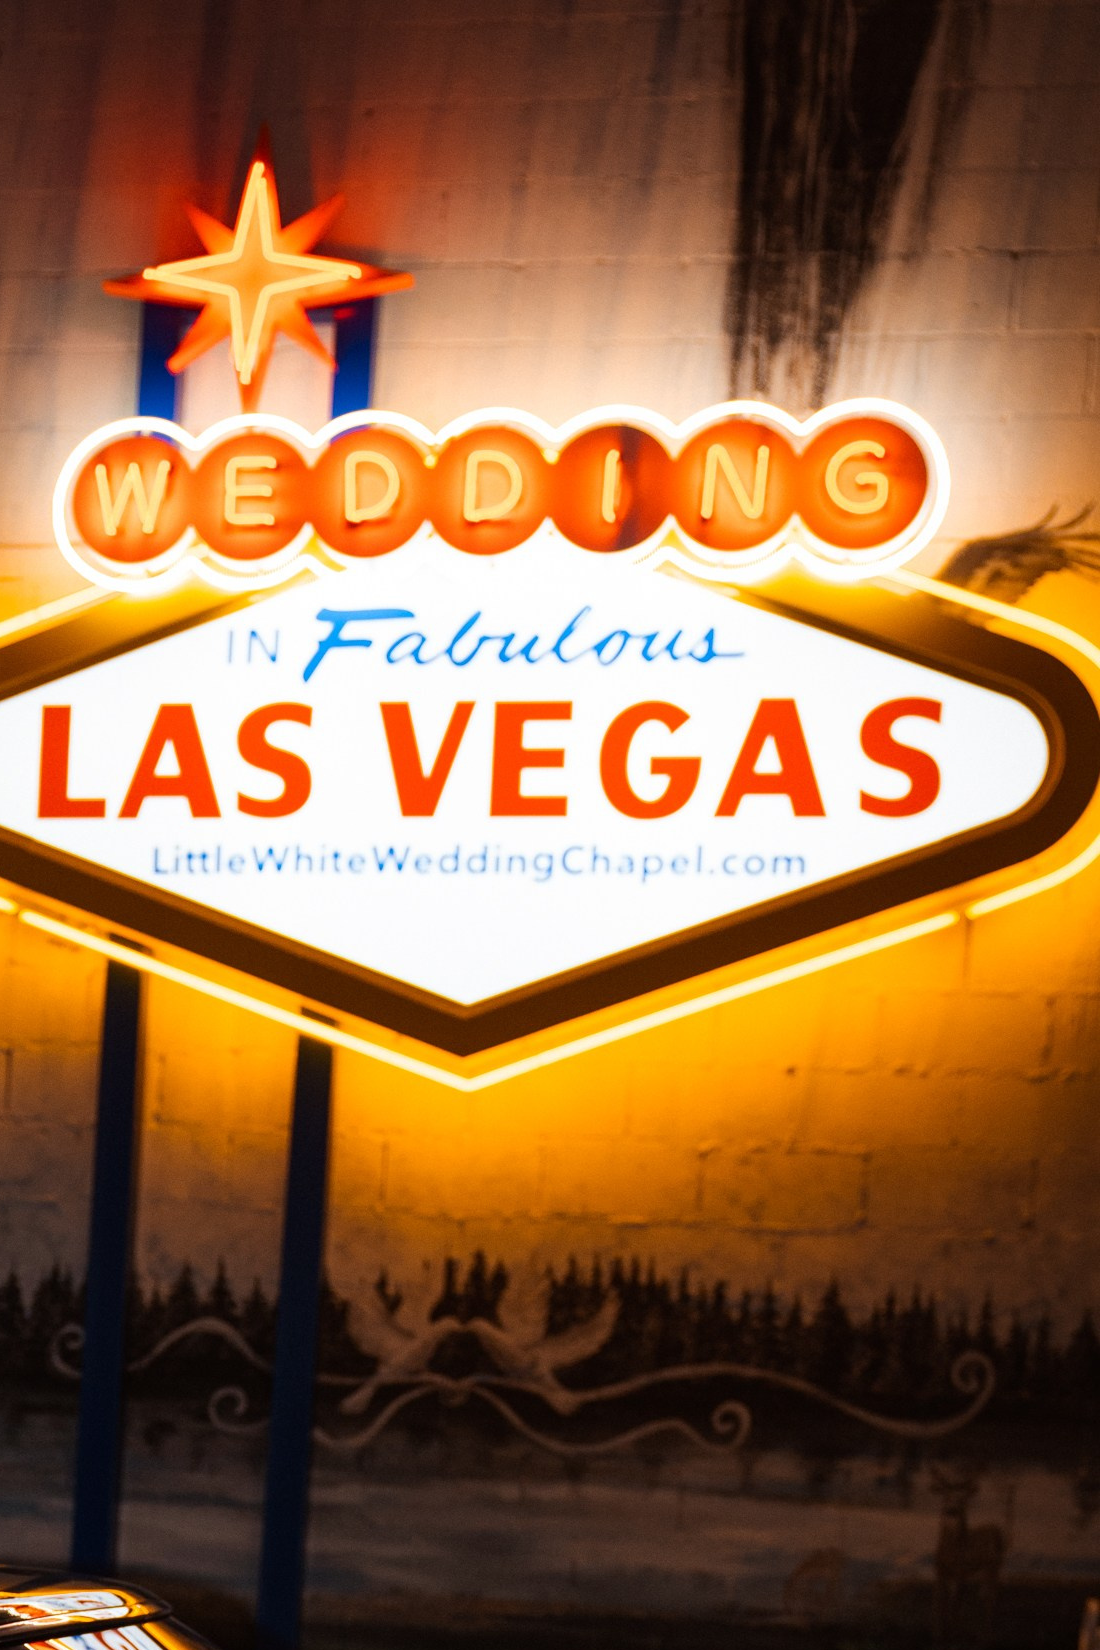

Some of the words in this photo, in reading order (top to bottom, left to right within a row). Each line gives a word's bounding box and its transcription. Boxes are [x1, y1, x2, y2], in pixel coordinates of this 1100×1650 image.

[96, 439, 892, 536] WEDDING
[226, 628, 280, 664] IN
[302, 606, 746, 683] Fabulous
[37, 701, 313, 819] LAS
[379, 697, 943, 820] VEGAS
[153, 843, 808, 884] LittleWhiteWeddingChapel.com
